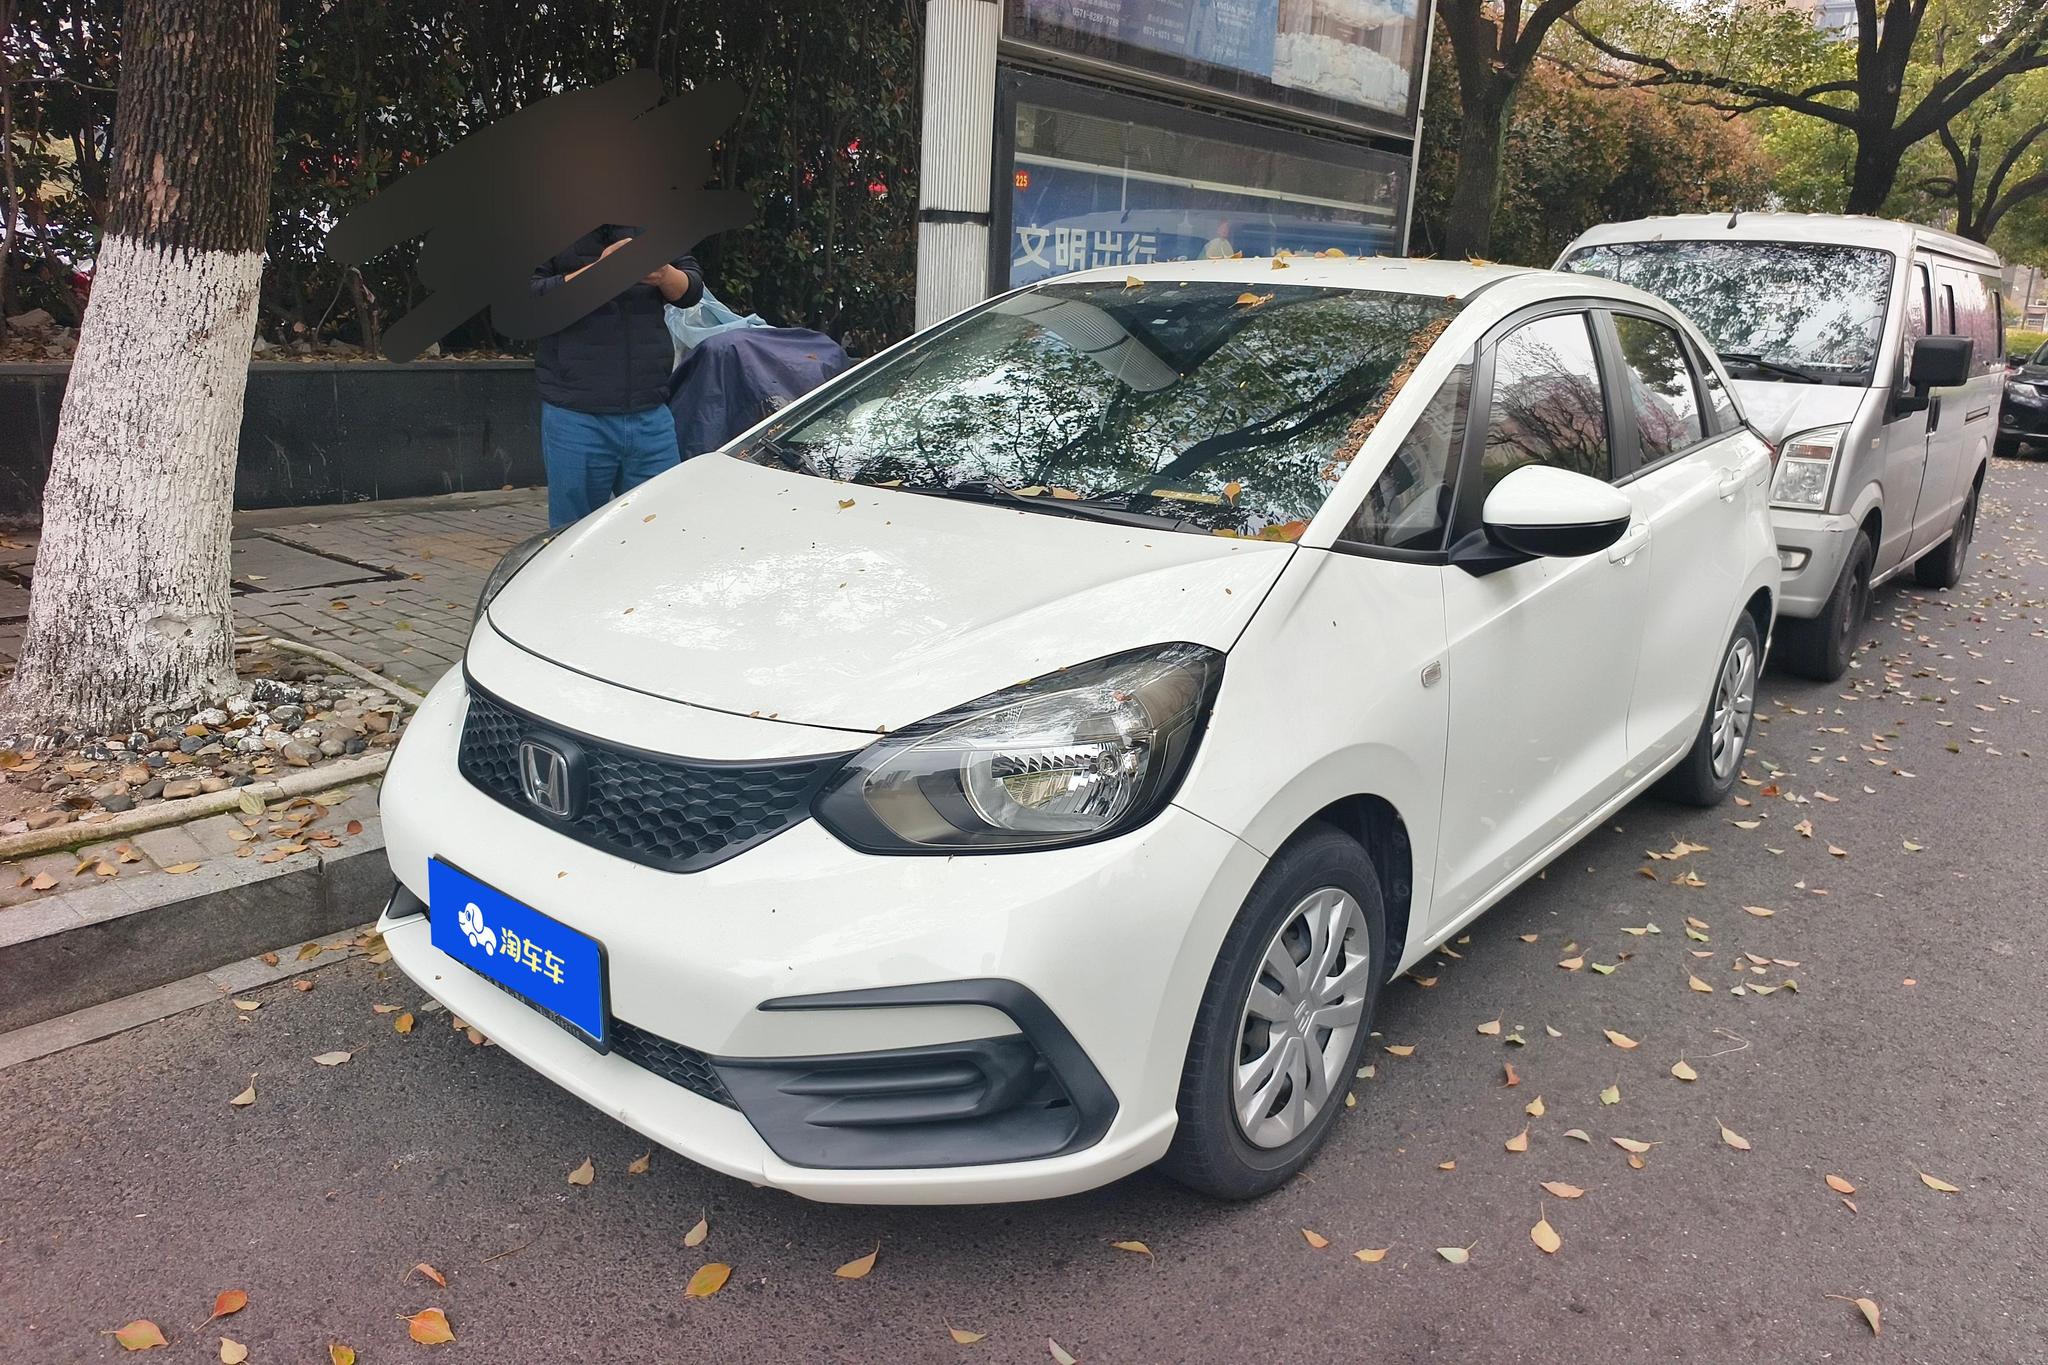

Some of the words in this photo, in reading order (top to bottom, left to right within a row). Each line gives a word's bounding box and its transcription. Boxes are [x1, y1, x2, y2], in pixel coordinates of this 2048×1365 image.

[1015, 174, 1028, 188] 225
[1013, 223, 1157, 271] 文明出行
